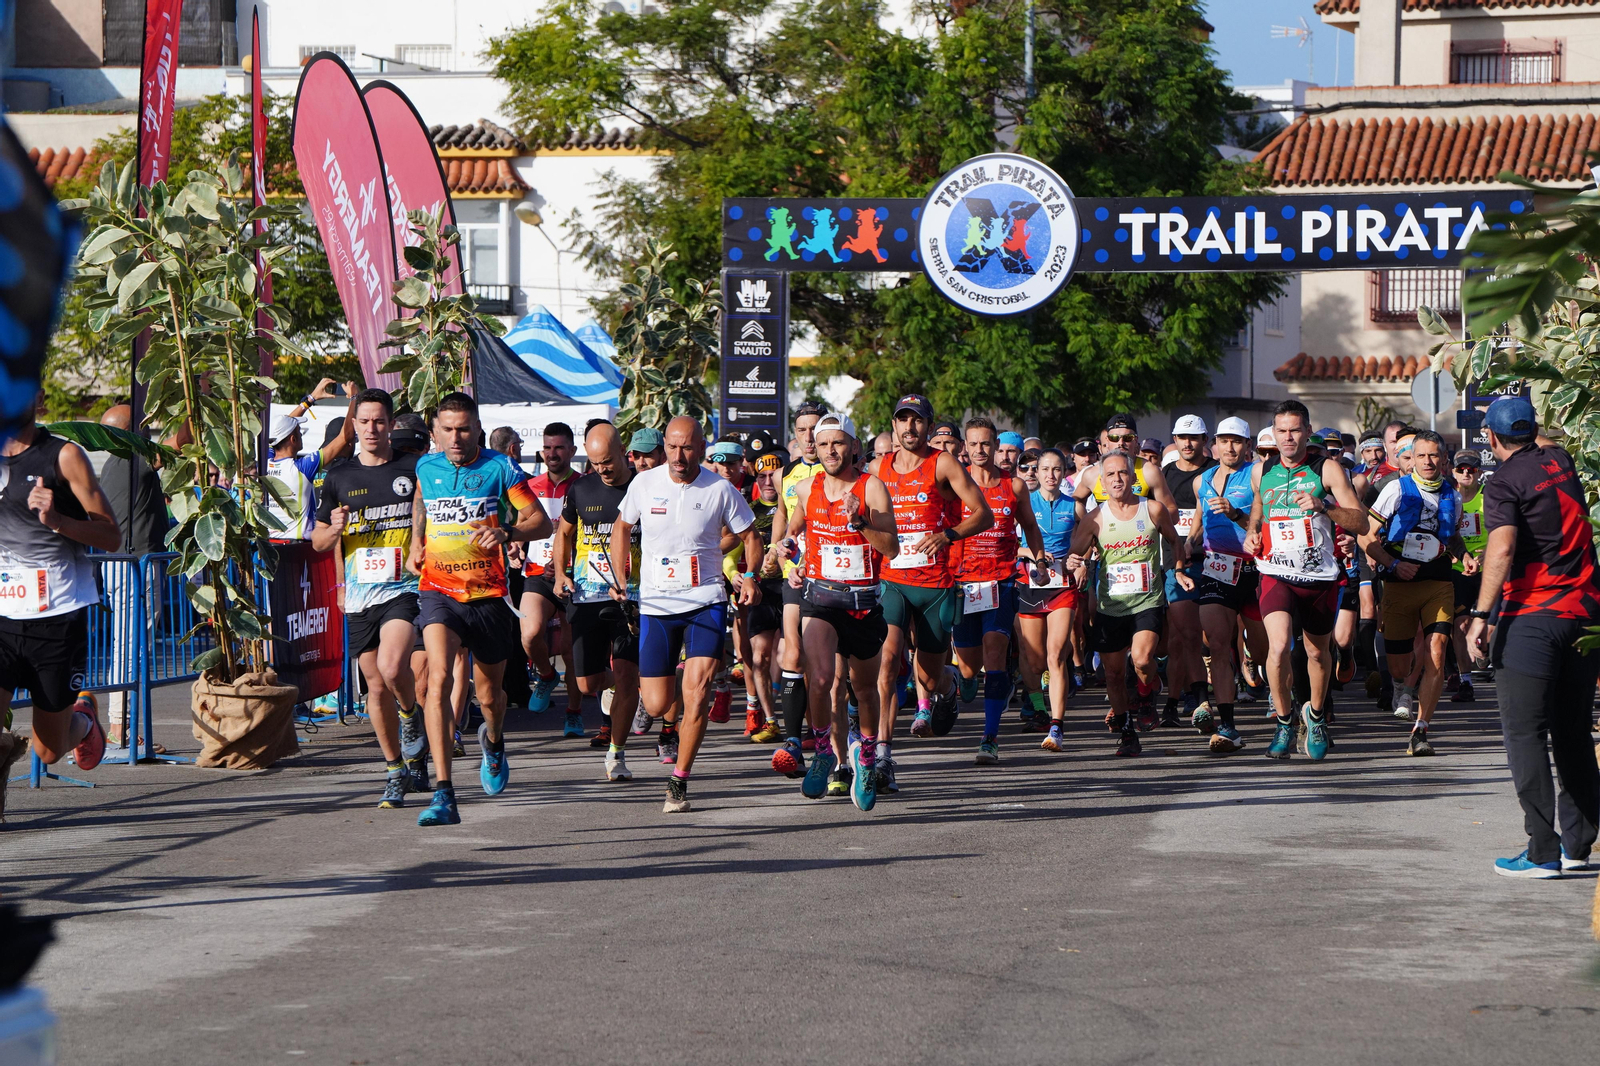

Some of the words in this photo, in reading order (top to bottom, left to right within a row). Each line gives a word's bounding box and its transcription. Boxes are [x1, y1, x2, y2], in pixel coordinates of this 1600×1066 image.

[934, 166, 994, 208] TRAIL
[997, 164, 1067, 221] PIRATA
[1119, 211, 1282, 255] TRAIL
[929, 237, 950, 279] SIERRA
[946, 276, 968, 297] SAN
[1044, 244, 1068, 282] 2023
[734, 346, 772, 356] INAUTO
[891, 494, 917, 503] vijerez
[438, 499, 464, 510] TRAIL
[433, 511, 457, 523] TEAM
[1281, 530, 1295, 540] 53
[1420, 542, 1424, 551] 1
[364, 559, 387, 570] 359
[434, 559, 493, 574] Algeciras
[835, 556, 851, 569] 23
[1210, 561, 1227, 572] 439
[667, 567, 676, 578] 2
[1116, 574, 1135, 583] 250
[0, 585, 26, 599] 440
[969, 592, 983, 603] 54
[286, 607, 330, 642] TEAMERGY
